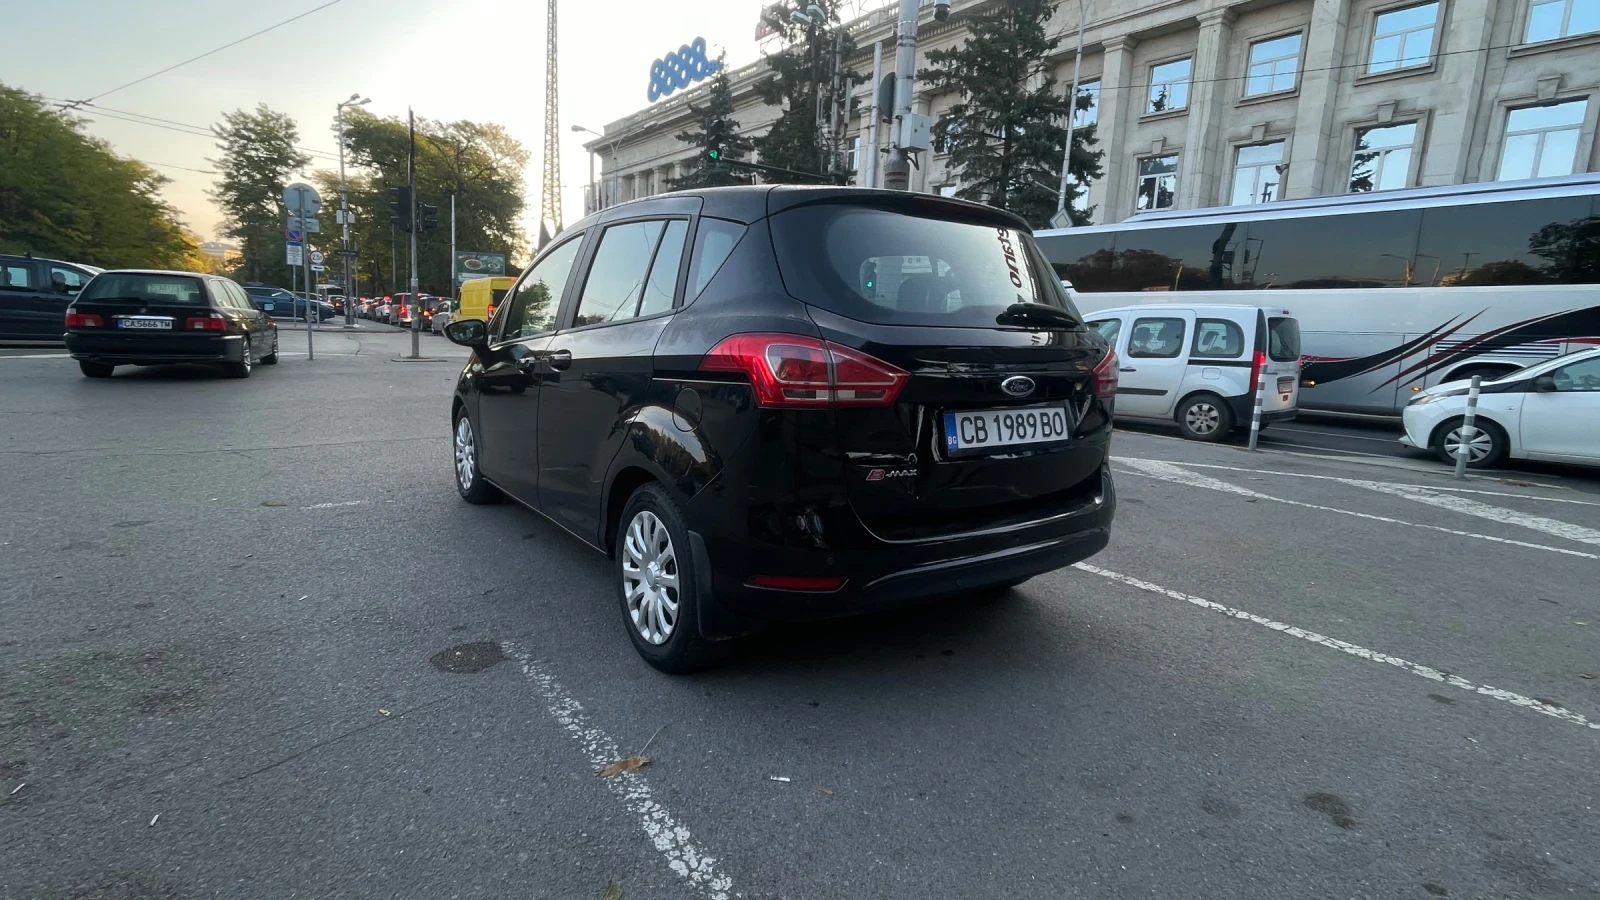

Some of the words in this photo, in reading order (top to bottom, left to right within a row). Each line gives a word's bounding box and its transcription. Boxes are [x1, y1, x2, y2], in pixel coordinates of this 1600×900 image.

[960, 415, 989, 444] CB
[993, 412, 1037, 442] 1989
[1039, 411, 1064, 438] BO
[947, 436, 958, 445] BG
[866, 468, 918, 481] B-MAX
